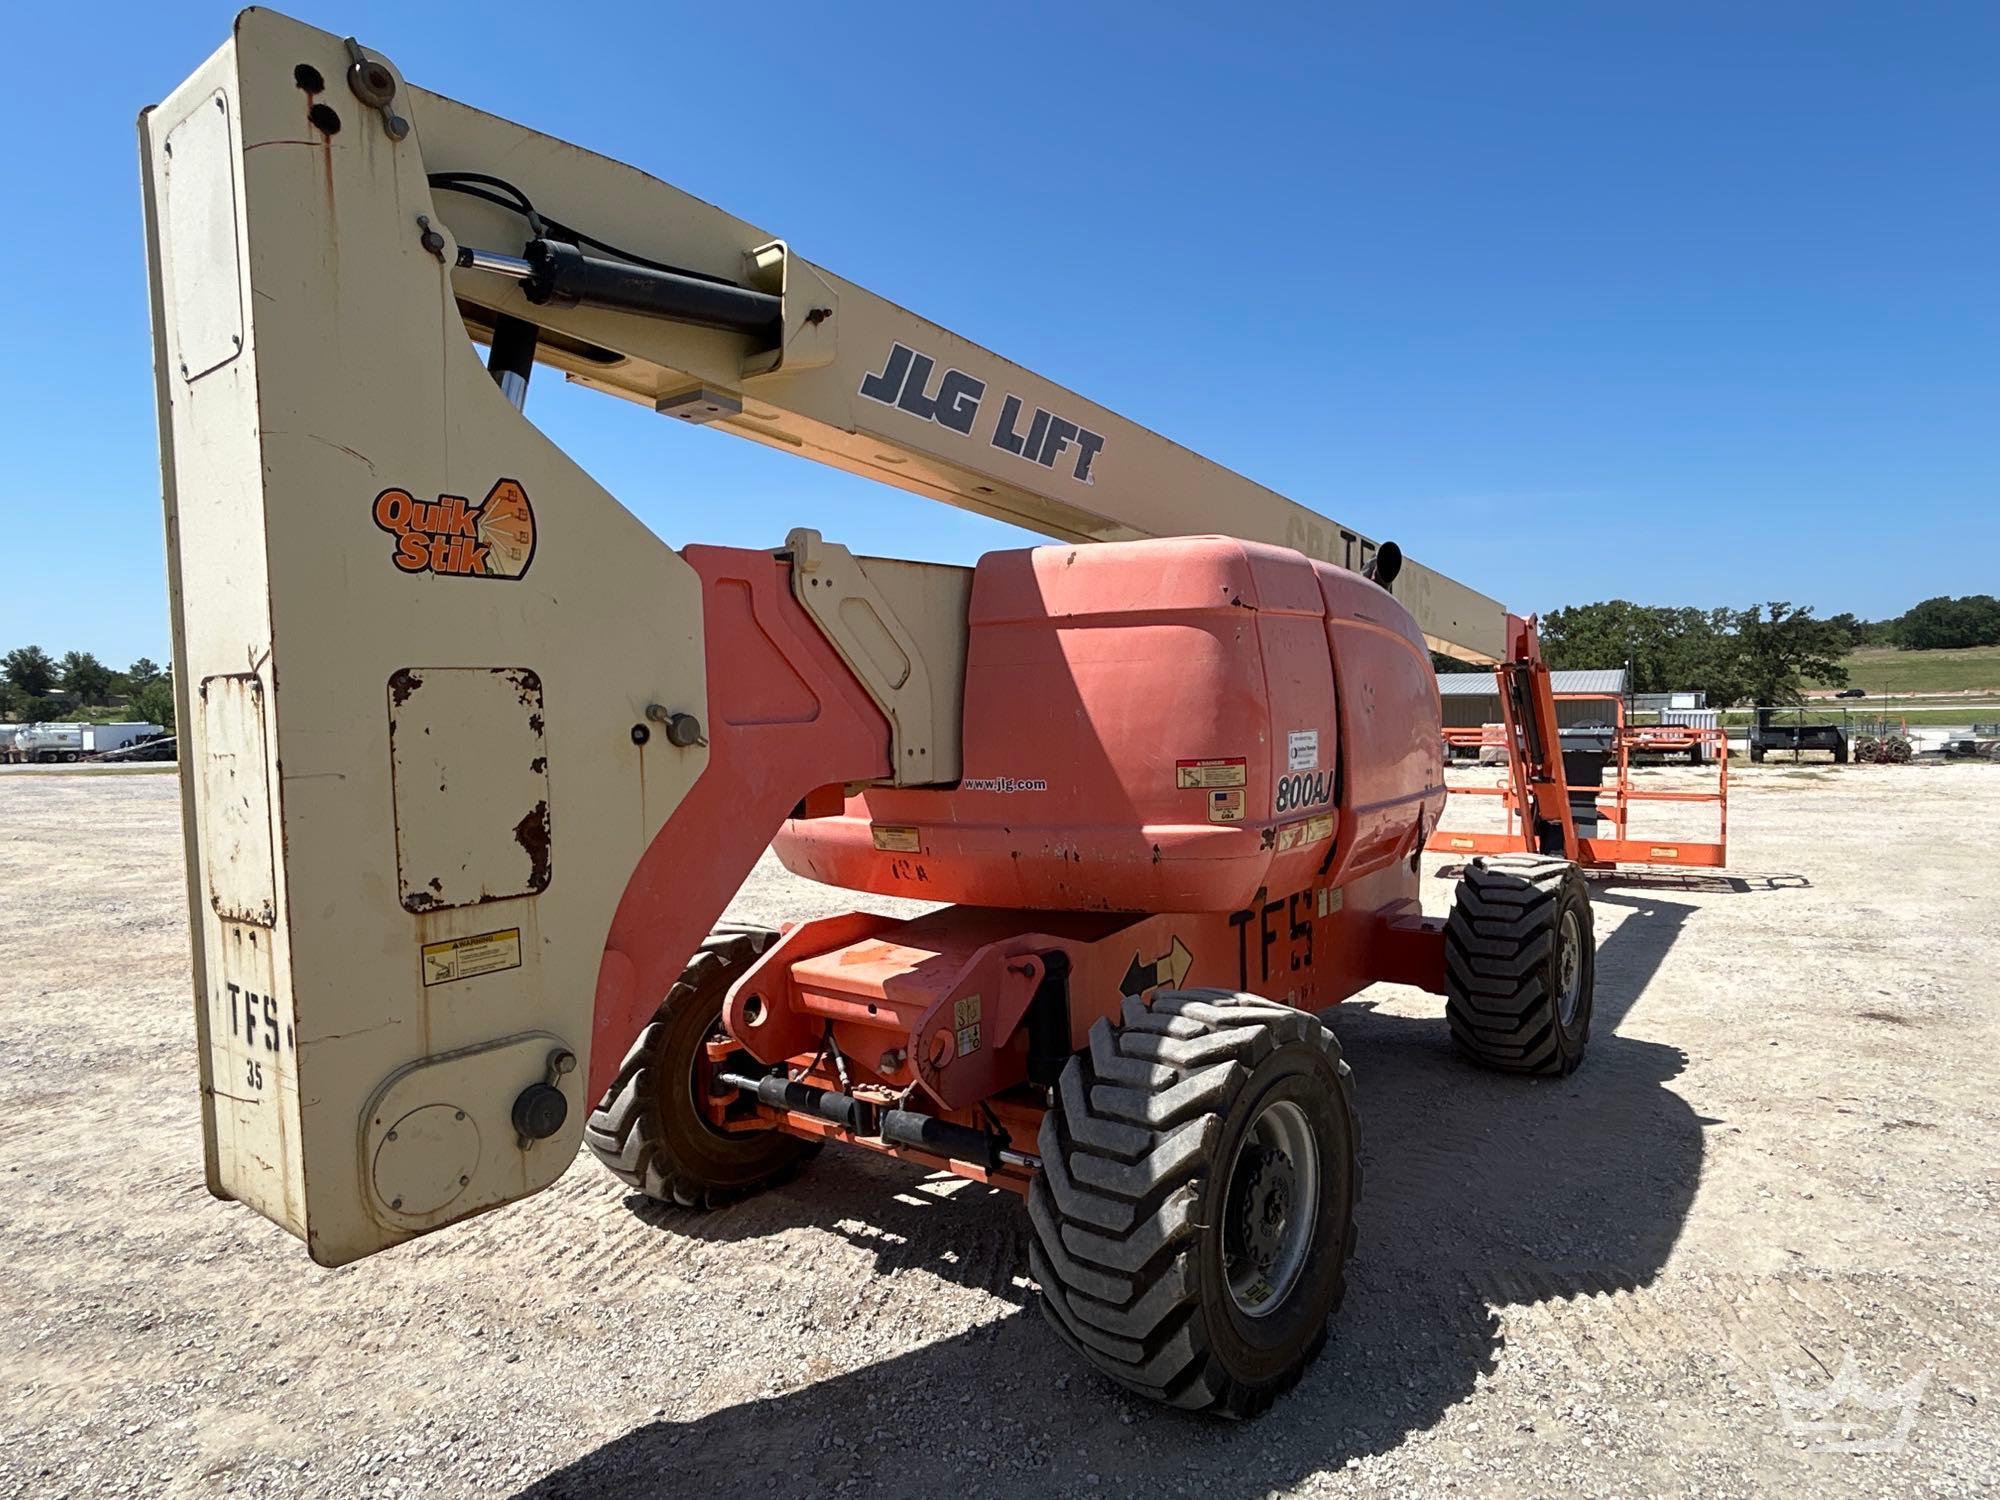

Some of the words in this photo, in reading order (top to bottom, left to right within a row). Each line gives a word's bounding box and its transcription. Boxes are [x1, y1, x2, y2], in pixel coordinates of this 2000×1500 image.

[858, 341, 987, 437] JLG
[990, 393, 1106, 483] LIFT
[376, 491, 480, 537] Quik
[395, 531, 491, 575] Stik
[964, 777, 1047, 793] www.jlg.com
[1276, 769, 1335, 813] 800AJ
[458, 935, 494, 949] WARNING
[227, 982, 280, 1052] TFS
[247, 1058, 263, 1090] 35
